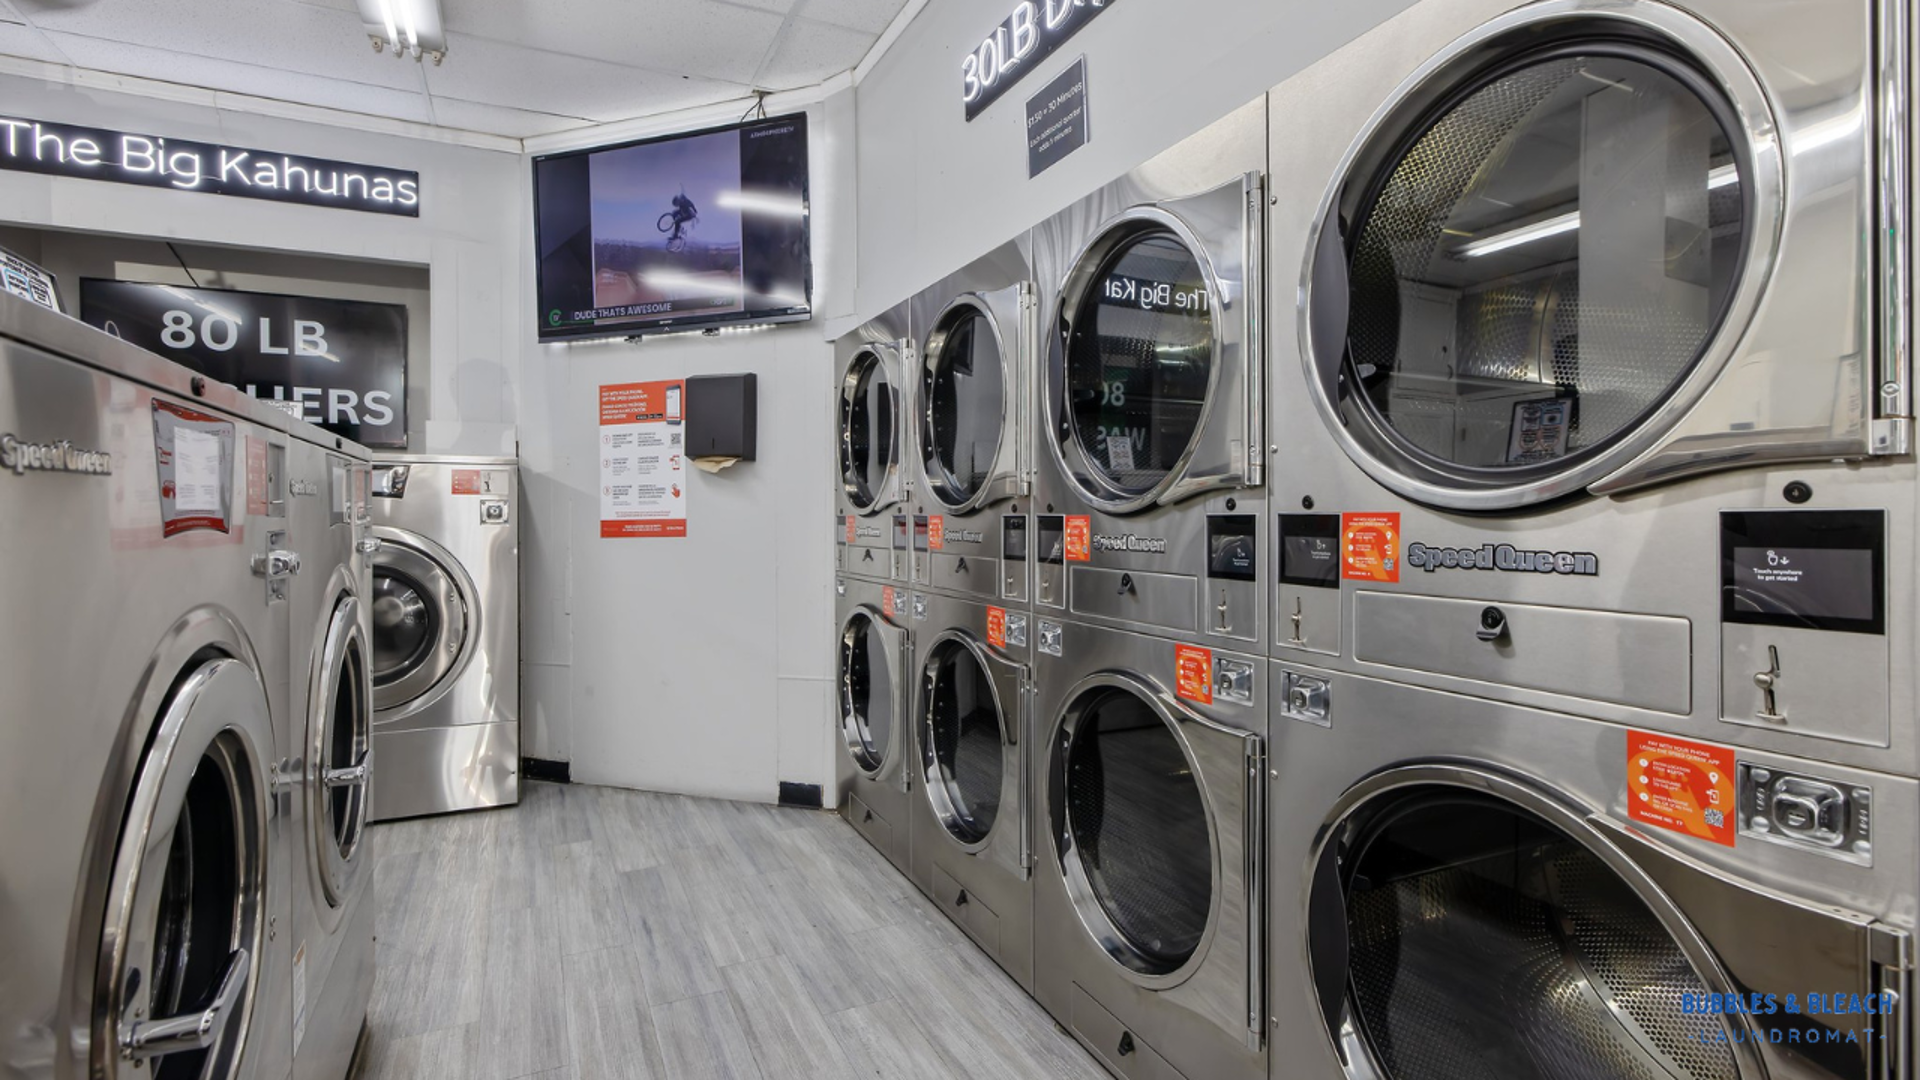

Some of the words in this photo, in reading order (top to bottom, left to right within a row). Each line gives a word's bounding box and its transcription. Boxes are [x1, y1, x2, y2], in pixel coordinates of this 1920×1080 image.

[1048, 99, 1057, 114] 30
[1057, 82, 1082, 106] Minutes
[0, 117, 101, 164] The
[121, 135, 202, 189] Big
[221, 148, 418, 206] Kahunas
[574, 309, 597, 320] DUDE
[598, 306, 626, 318] THATS
[627, 303, 672, 316] AWESOME
[160, 309, 238, 352] 80
[258, 316, 329, 357] LB
[1093, 533, 1127, 553] Speed
[1127, 534, 1167, 554] Queen
[1408, 541, 1494, 573] Speed
[1494, 545, 1599, 576] Queen
[1639, 744, 1657, 753] USING
[1657, 747, 1667, 755] THE
[1667, 750, 1685, 759] SPEED
[1685, 752, 1708, 763] QUEEN
[1708, 757, 1720, 765] APP
[1673, 744, 1689, 753] YOUR
[1690, 747, 1711, 758] PHONE
[1640, 810, 1663, 821] MACHINE
